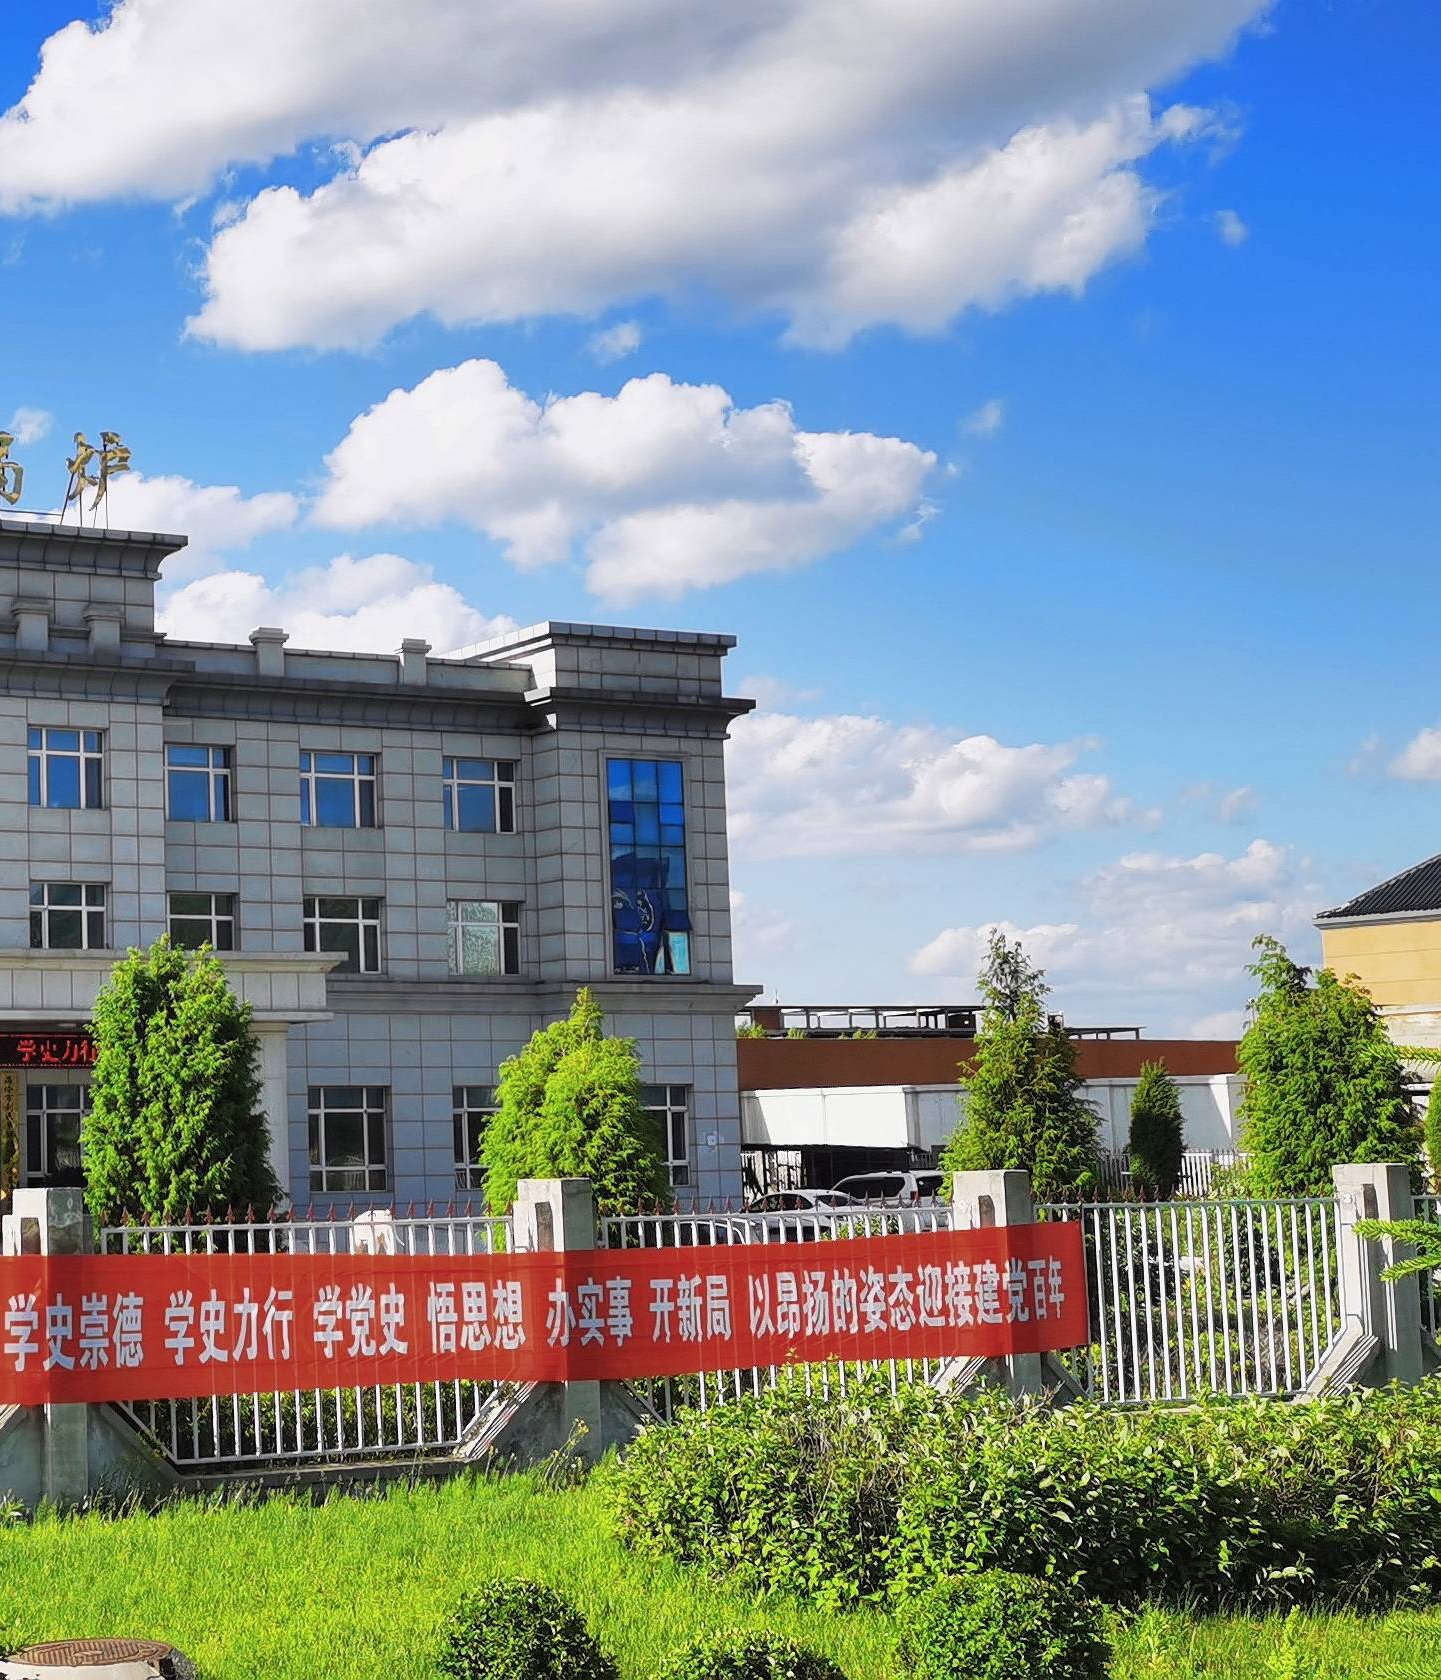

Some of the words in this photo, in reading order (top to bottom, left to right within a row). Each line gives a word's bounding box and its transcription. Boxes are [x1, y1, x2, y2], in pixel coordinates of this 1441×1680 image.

[4, 1292, 143, 1371] 学史崇德
[165, 1286, 292, 1365] 学史力行
[313, 1283, 408, 1358] 学党史
[428, 1280, 526, 1353] 悟思想
[546, 1276, 632, 1346] 办实事
[650, 1274, 731, 1342] 开新局
[749, 1257, 1064, 1339] 以昂扬的姿态迎接建党百年
